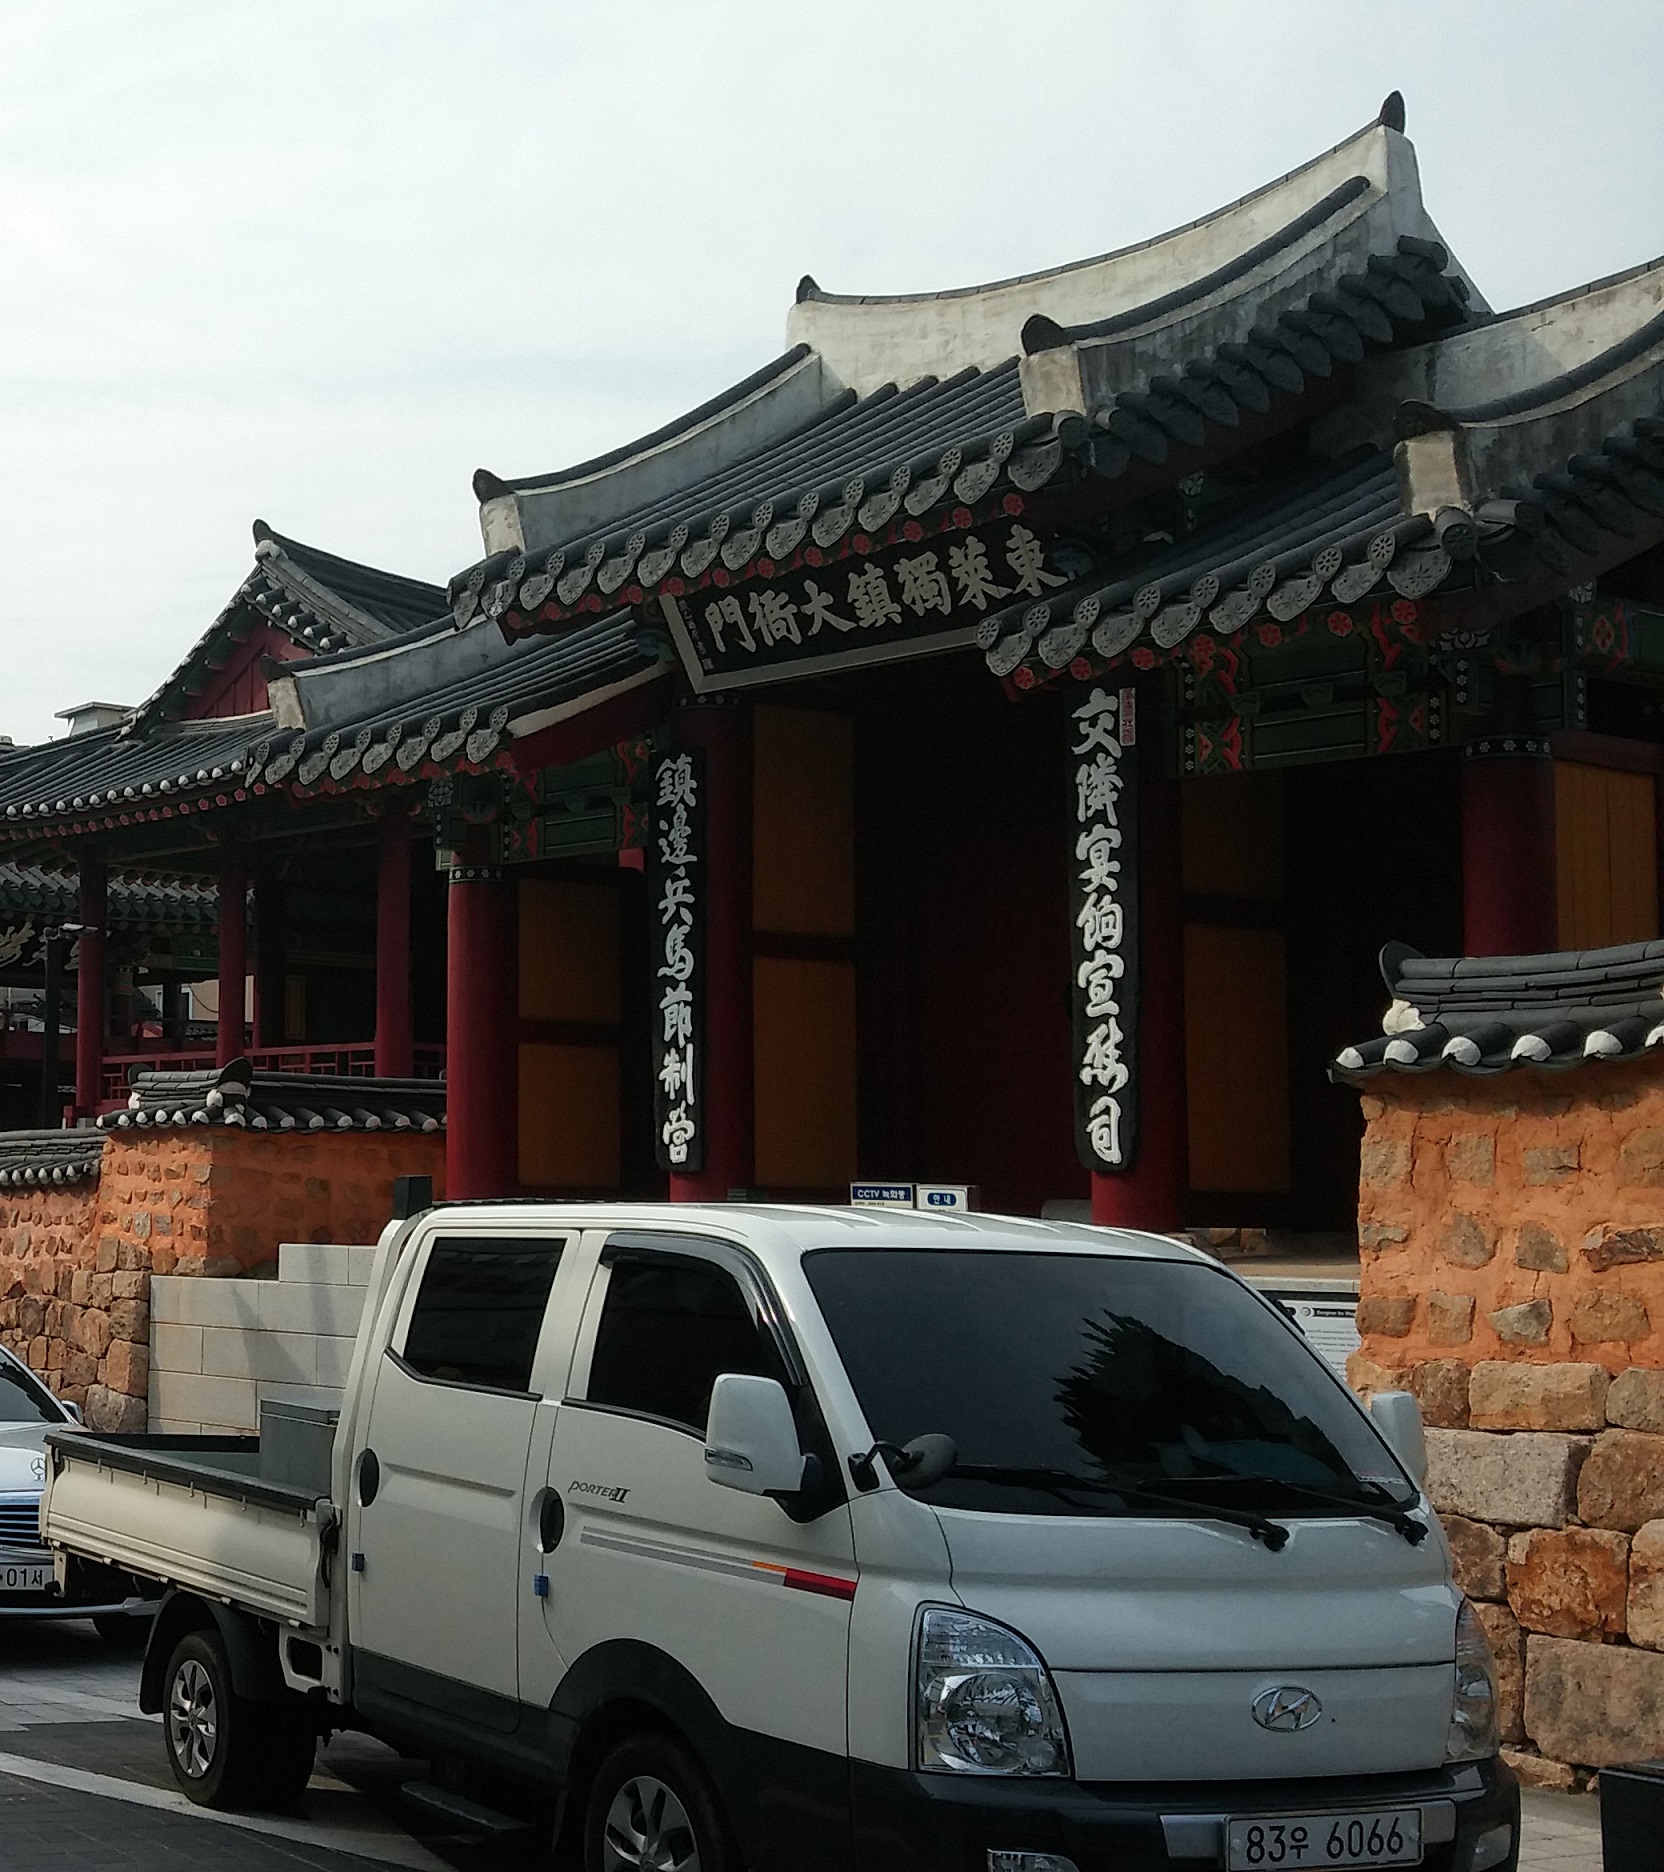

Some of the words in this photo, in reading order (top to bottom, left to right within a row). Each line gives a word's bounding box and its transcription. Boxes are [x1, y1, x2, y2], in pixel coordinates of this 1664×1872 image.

[857, 1189, 880, 1198] CCTV
[7, 1568, 44, 1587] 01서
[1246, 1825, 1309, 1864] 83우
[1327, 1817, 1404, 1859] 6066
